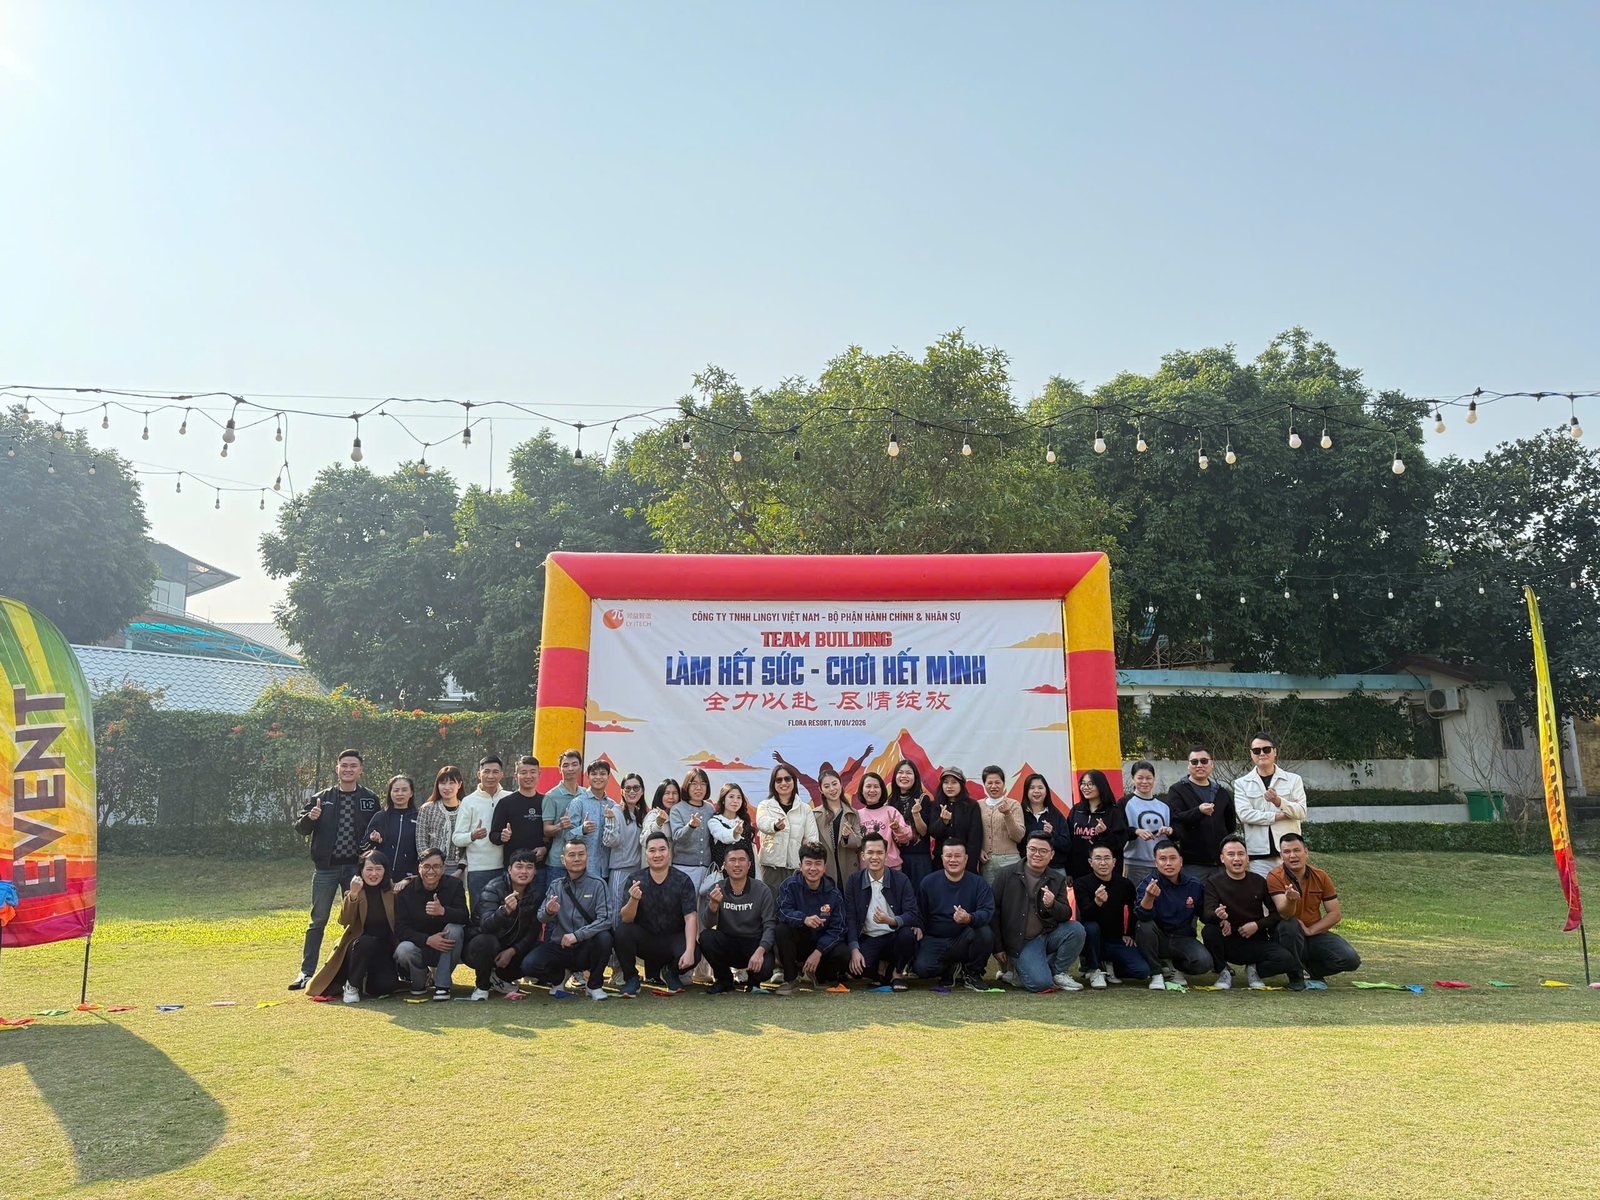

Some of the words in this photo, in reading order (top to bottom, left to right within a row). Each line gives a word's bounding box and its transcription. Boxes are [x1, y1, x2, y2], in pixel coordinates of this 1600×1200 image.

[692, 610, 714, 622] CÔNG
[716, 612, 726, 622] TY
[729, 612, 751, 622] TNHH
[753, 612, 779, 622] LINGYI
[782, 610, 800, 624] VIỆT
[802, 612, 820, 622] NAM
[827, 610, 839, 624] BỘ
[841, 611, 863, 624] PHẬN
[865, 610, 887, 621] HÀNH
[889, 610, 914, 621] CHÍNH
[916, 613, 922, 621] &
[925, 611, 948, 621] NHÂN
[950, 611, 961, 623] SỰ
[760, 631, 811, 647] TEAM
[814, 631, 893, 647] BUILDING
[665, 650, 712, 686] LÀM
[718, 647, 756, 686] HẾT
[761, 650, 805, 686] SỨC
[826, 652, 876, 686] CHƠI
[882, 647, 920, 685] HẾT
[926, 650, 987, 685] MÌNH
[703, 691, 819, 711] 全力以赴
[788, 719, 807, 727] FLORA
[808, 719, 833, 727] RESORT,
[834, 719, 867, 727] 11/01/2026
[13, 684, 67, 898] EVENT
[723, 901, 753, 911] IDENTIFY
